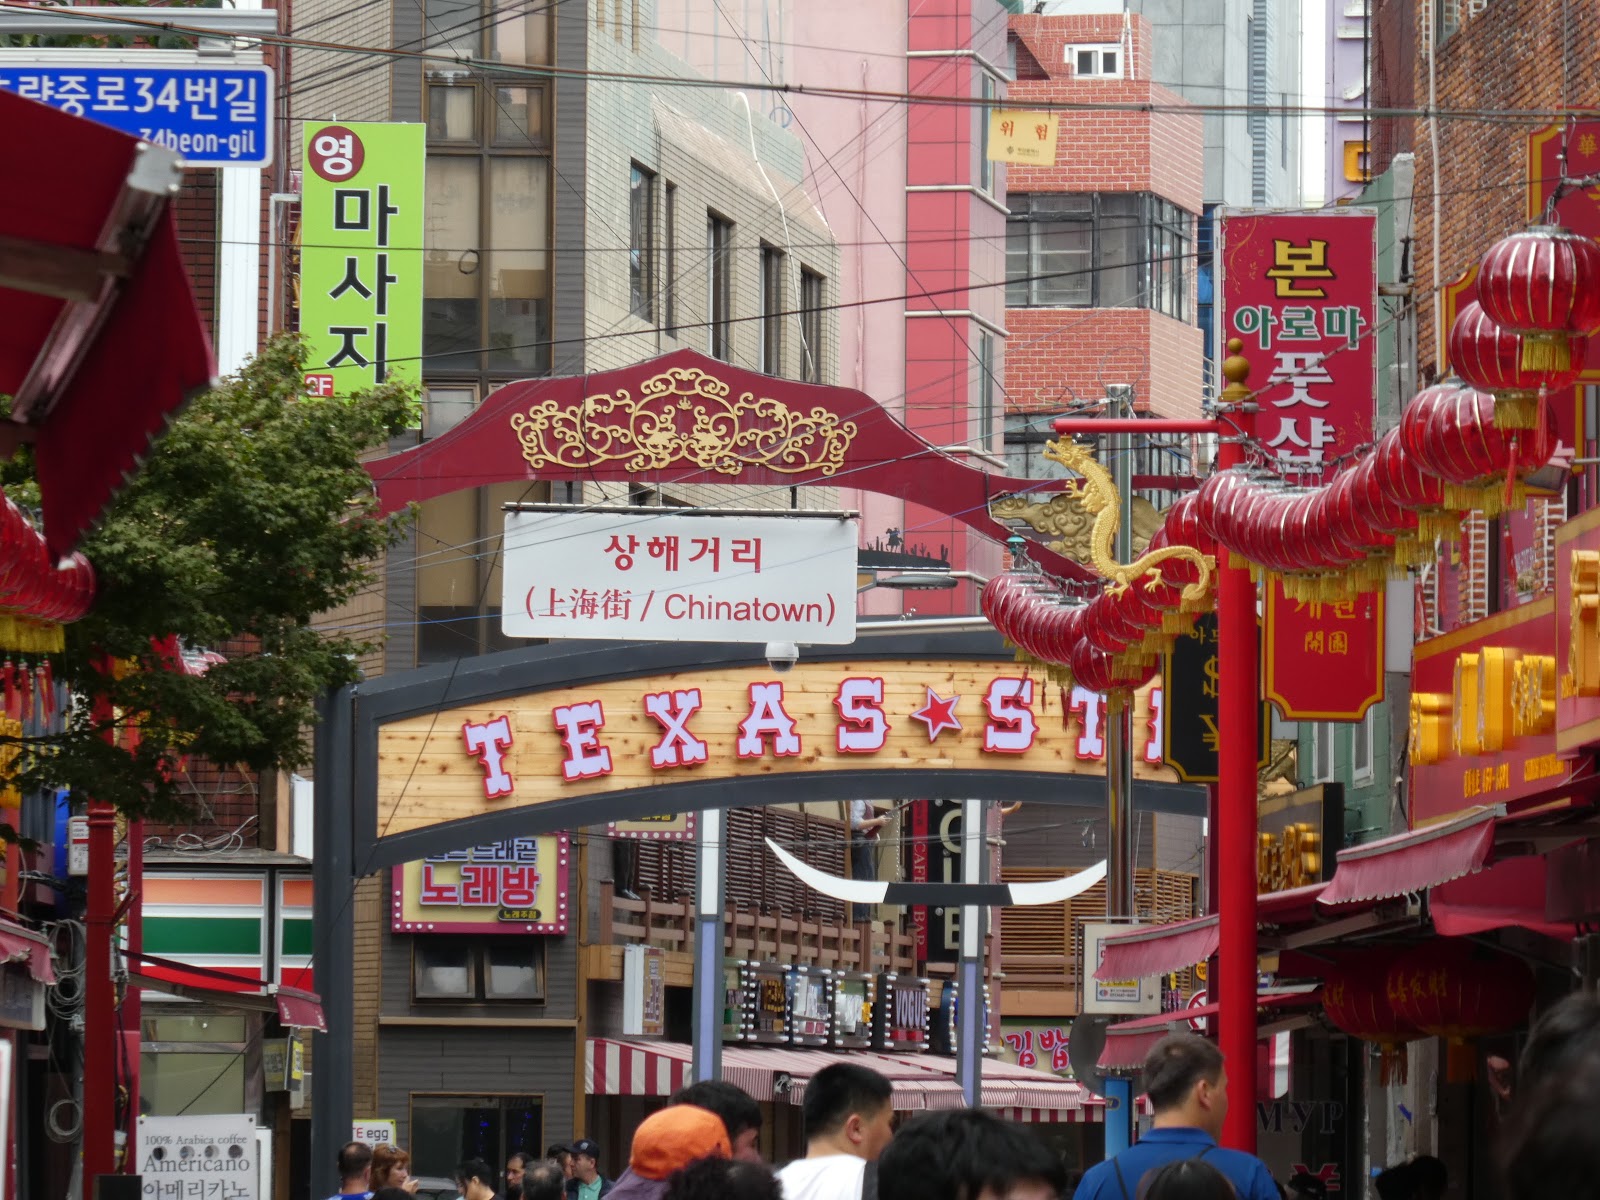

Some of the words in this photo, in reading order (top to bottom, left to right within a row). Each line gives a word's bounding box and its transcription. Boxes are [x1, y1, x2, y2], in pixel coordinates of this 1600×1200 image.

[314, 134, 354, 176] 영
[325, 183, 399, 385] 마사지
[1266, 239, 1336, 299] 본
[1233, 305, 1366, 350] 아로마
[603, 534, 763, 574] 상해거리
[462, 676, 892, 799] TEXAS
[420, 864, 541, 909] 노래방
[894, 989, 932, 1030] VOGUE
[1005, 1027, 1070, 1071] 김밥
[144, 1134, 172, 1146] 100%
[175, 1134, 215, 1146] Arabica
[217, 1133, 248, 1145] coffee
[366, 1129, 389, 1142] egg
[142, 1154, 250, 1173] Americano
[142, 1178, 250, 1200] 아메리카노
